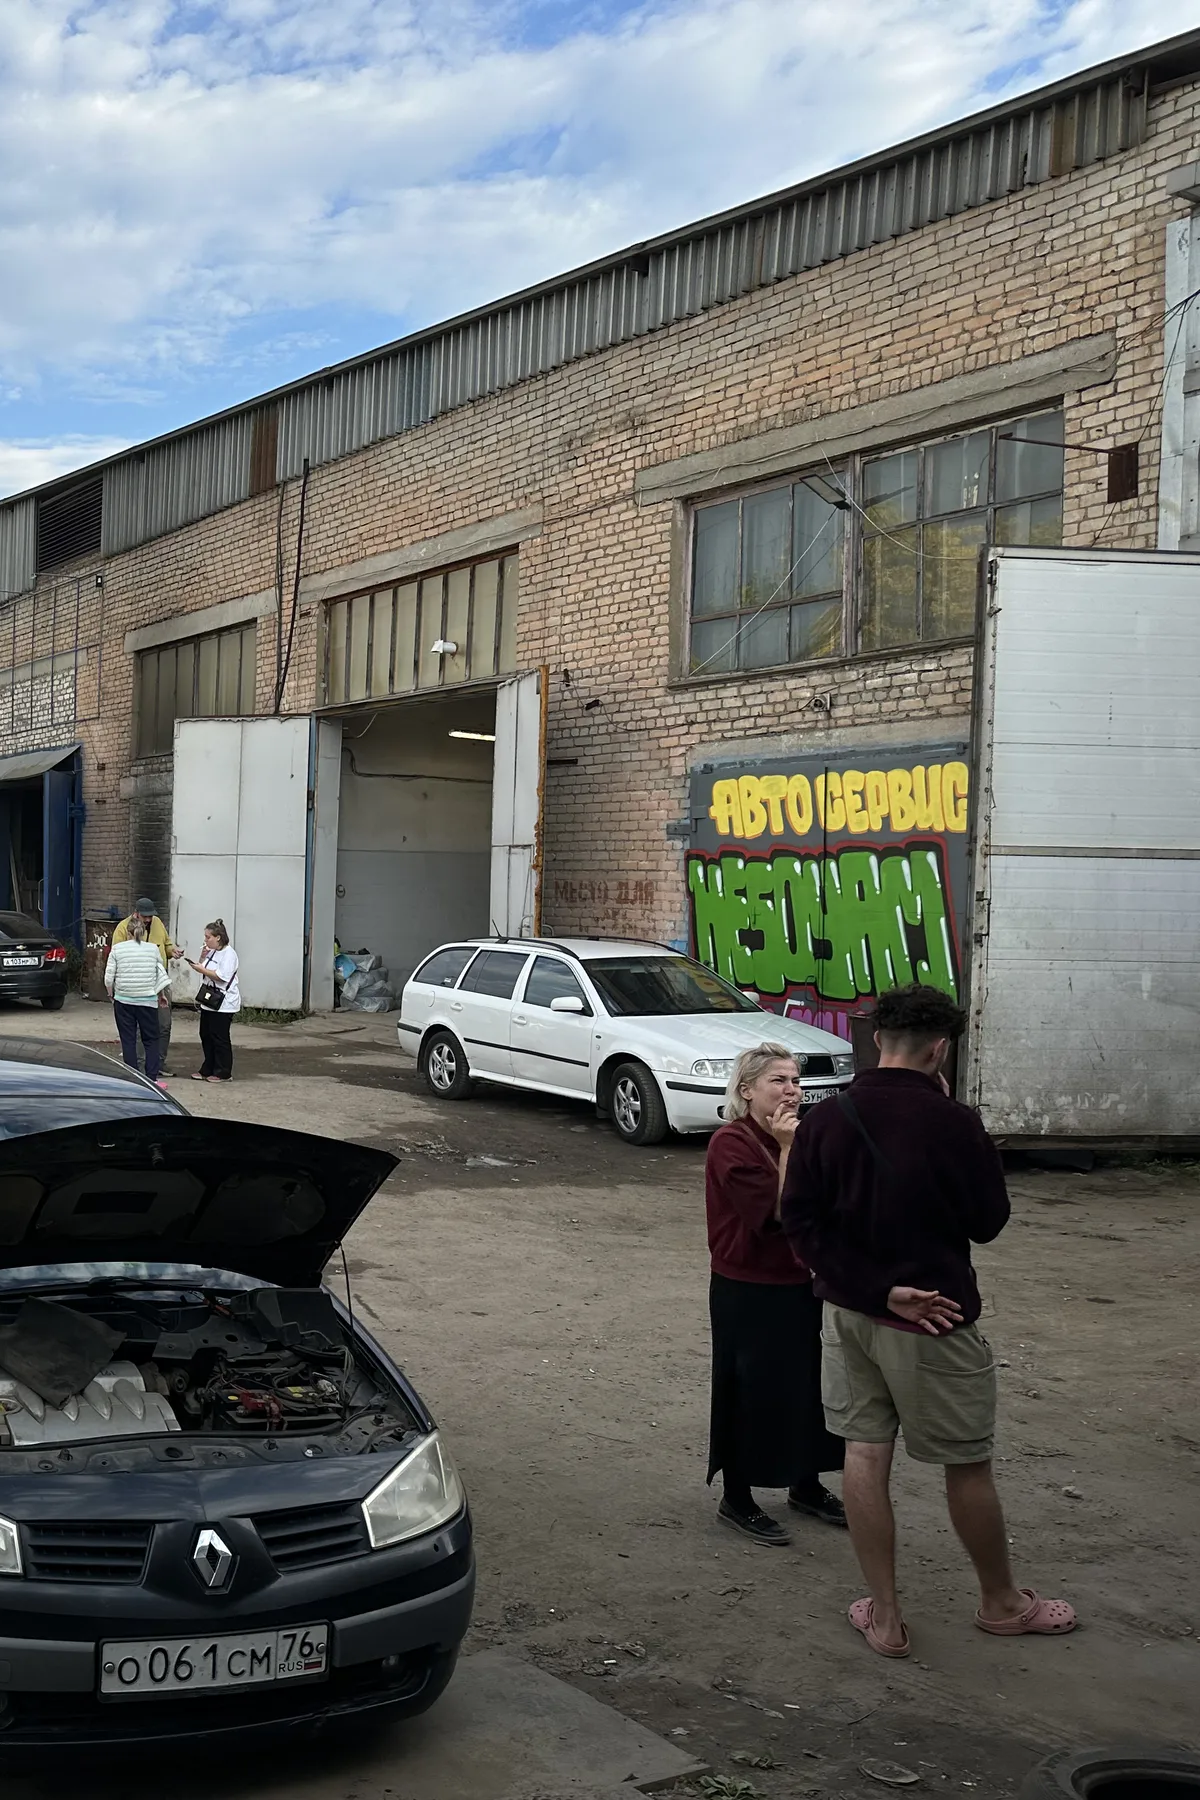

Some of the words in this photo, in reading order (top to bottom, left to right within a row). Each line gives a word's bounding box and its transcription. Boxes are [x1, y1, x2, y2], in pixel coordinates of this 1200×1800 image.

[709, 774, 813, 839] АВТО
[814, 762, 969, 834] СЕРВИС
[282, 1631, 314, 1662] 76
[279, 1661, 303, 1673] RUS
